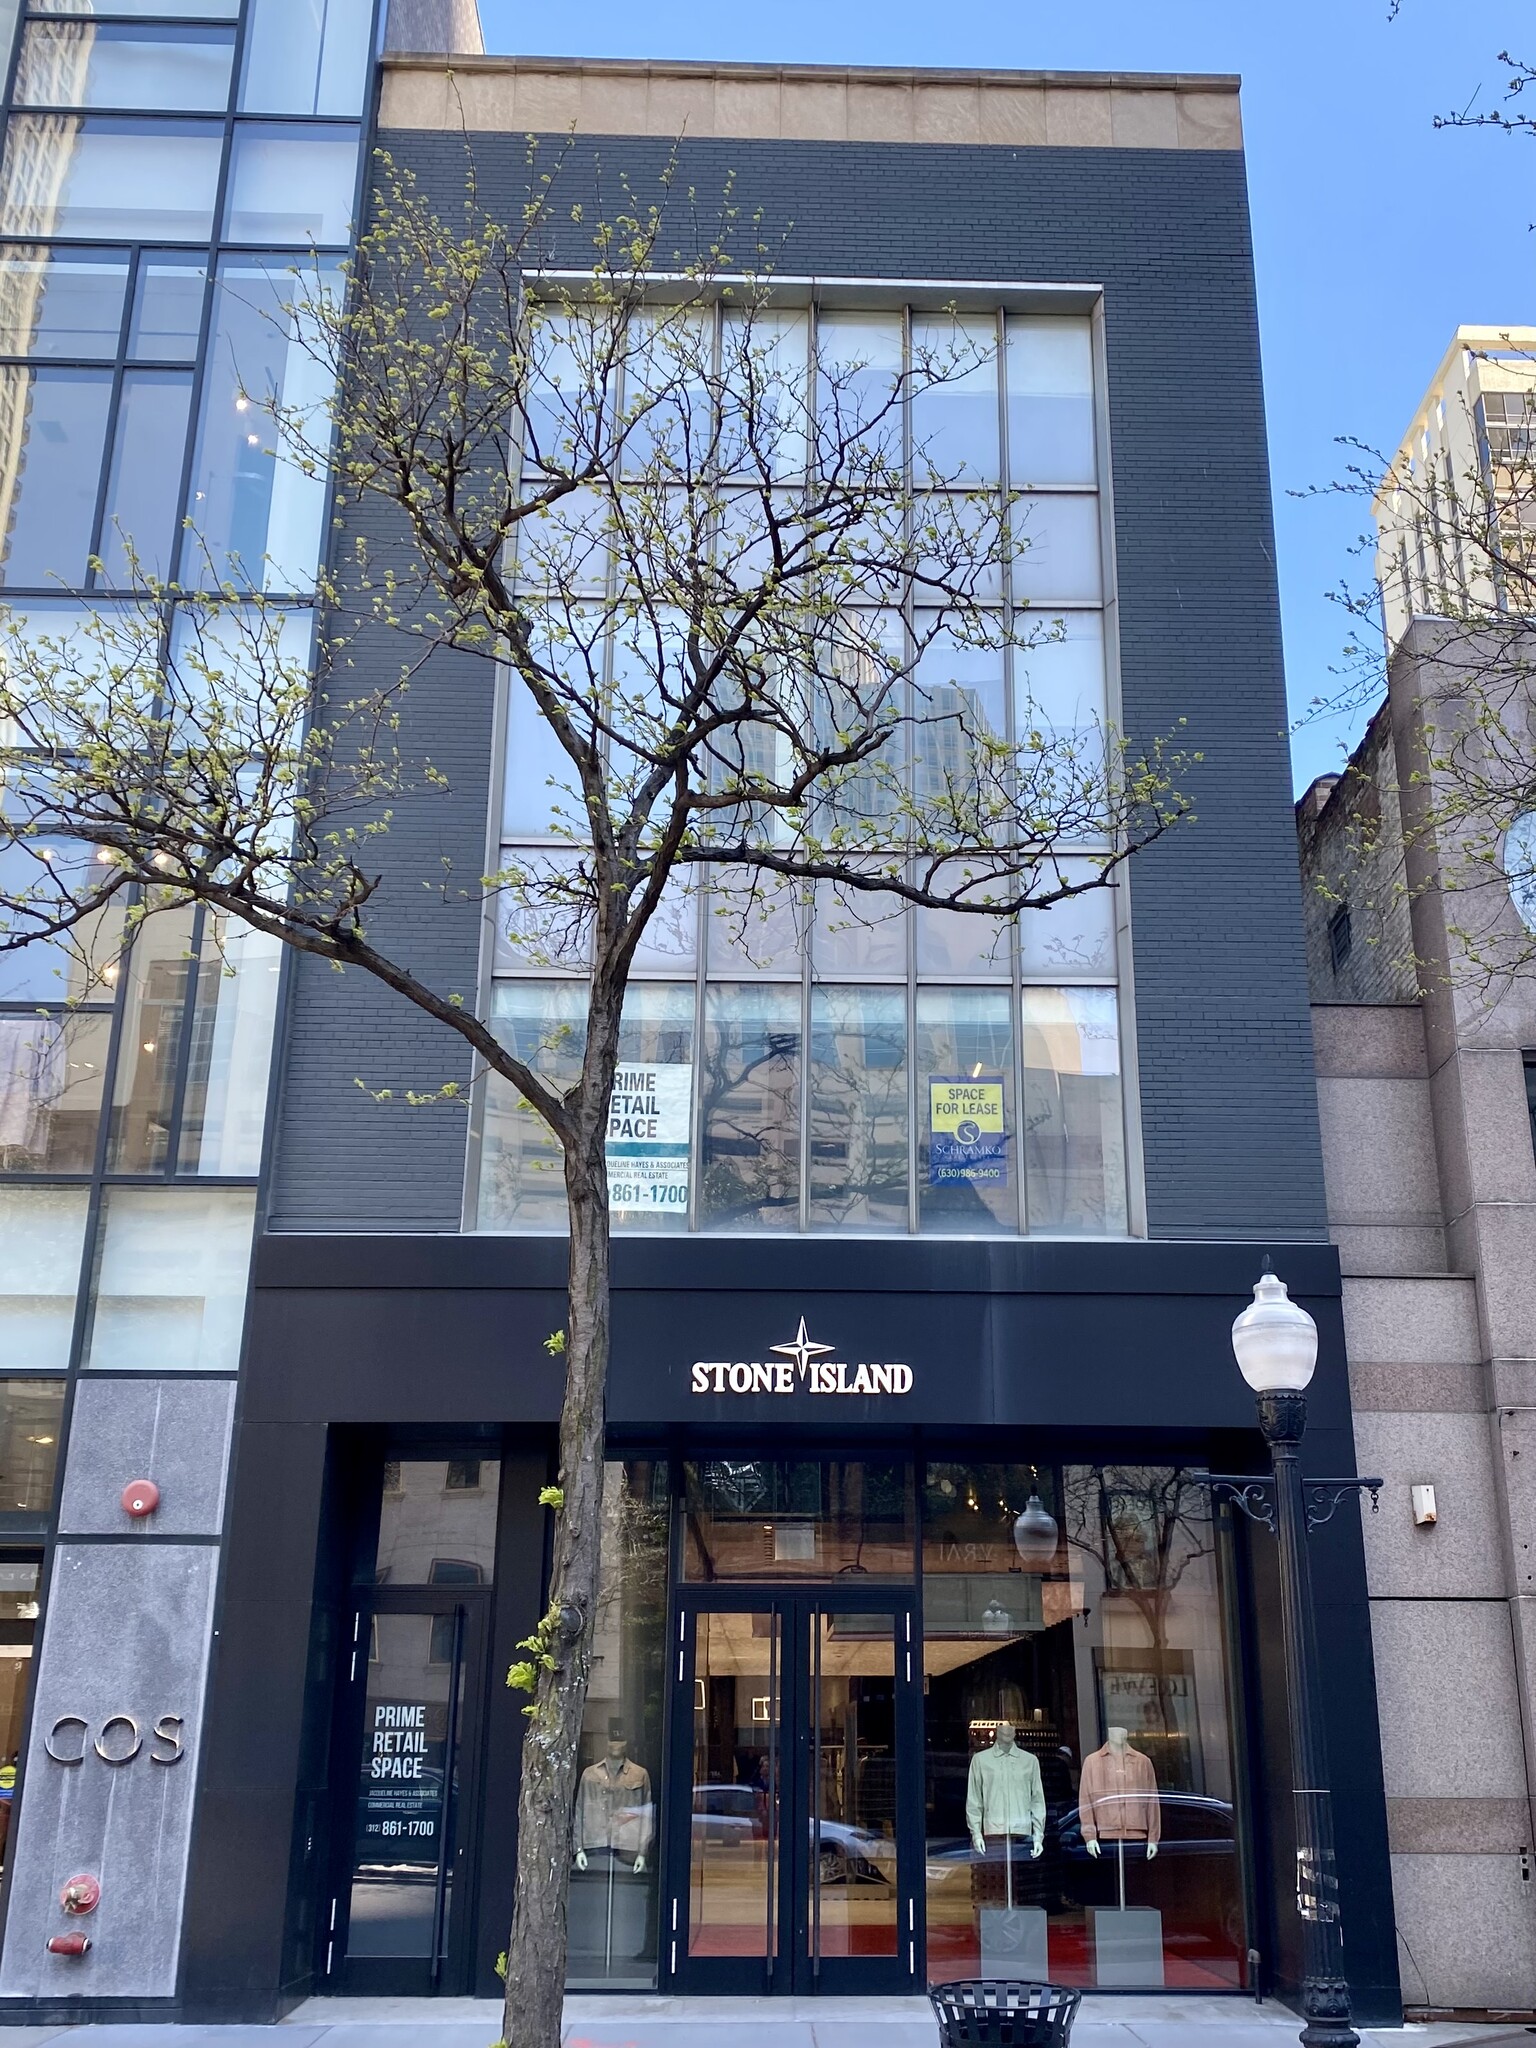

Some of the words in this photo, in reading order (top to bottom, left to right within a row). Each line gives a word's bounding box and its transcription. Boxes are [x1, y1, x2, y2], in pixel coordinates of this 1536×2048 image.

[612, 1072, 656, 1092] RIME
[948, 1088, 985, 1100] SPACE
[611, 1095, 660, 1115] ETAIL
[936, 1103, 959, 1115] FOR
[962, 1103, 998, 1115] LEASE
[606, 1118, 658, 1138] PACE
[935, 1143, 1001, 1155] SCHRAMKO
[631, 1161, 649, 1169] HAYES
[656, 1161, 688, 1169] ASSOCIATES
[607, 1171, 632, 1179] MERCIAL
[648, 1172, 668, 1180] ESTATE
[612, 1183, 688, 1204] 861-1700
[691, 1362, 795, 1393] STONE
[809, 1362, 914, 1394] ISLAND
[374, 1706, 426, 1728] PRIME
[44, 1716, 185, 1764] COS
[372, 1731, 429, 1753] RETAIL
[370, 1756, 423, 1779] SPACE
[394, 1789, 408, 1797] HAYES
[367, 1801, 394, 1809] COMMERCIAL
[395, 1801, 406, 1809] REAL
[407, 1801, 423, 1809] ESTATE
[366, 1823, 381, 1832] (312)
[382, 1820, 434, 1836] 861-1700
